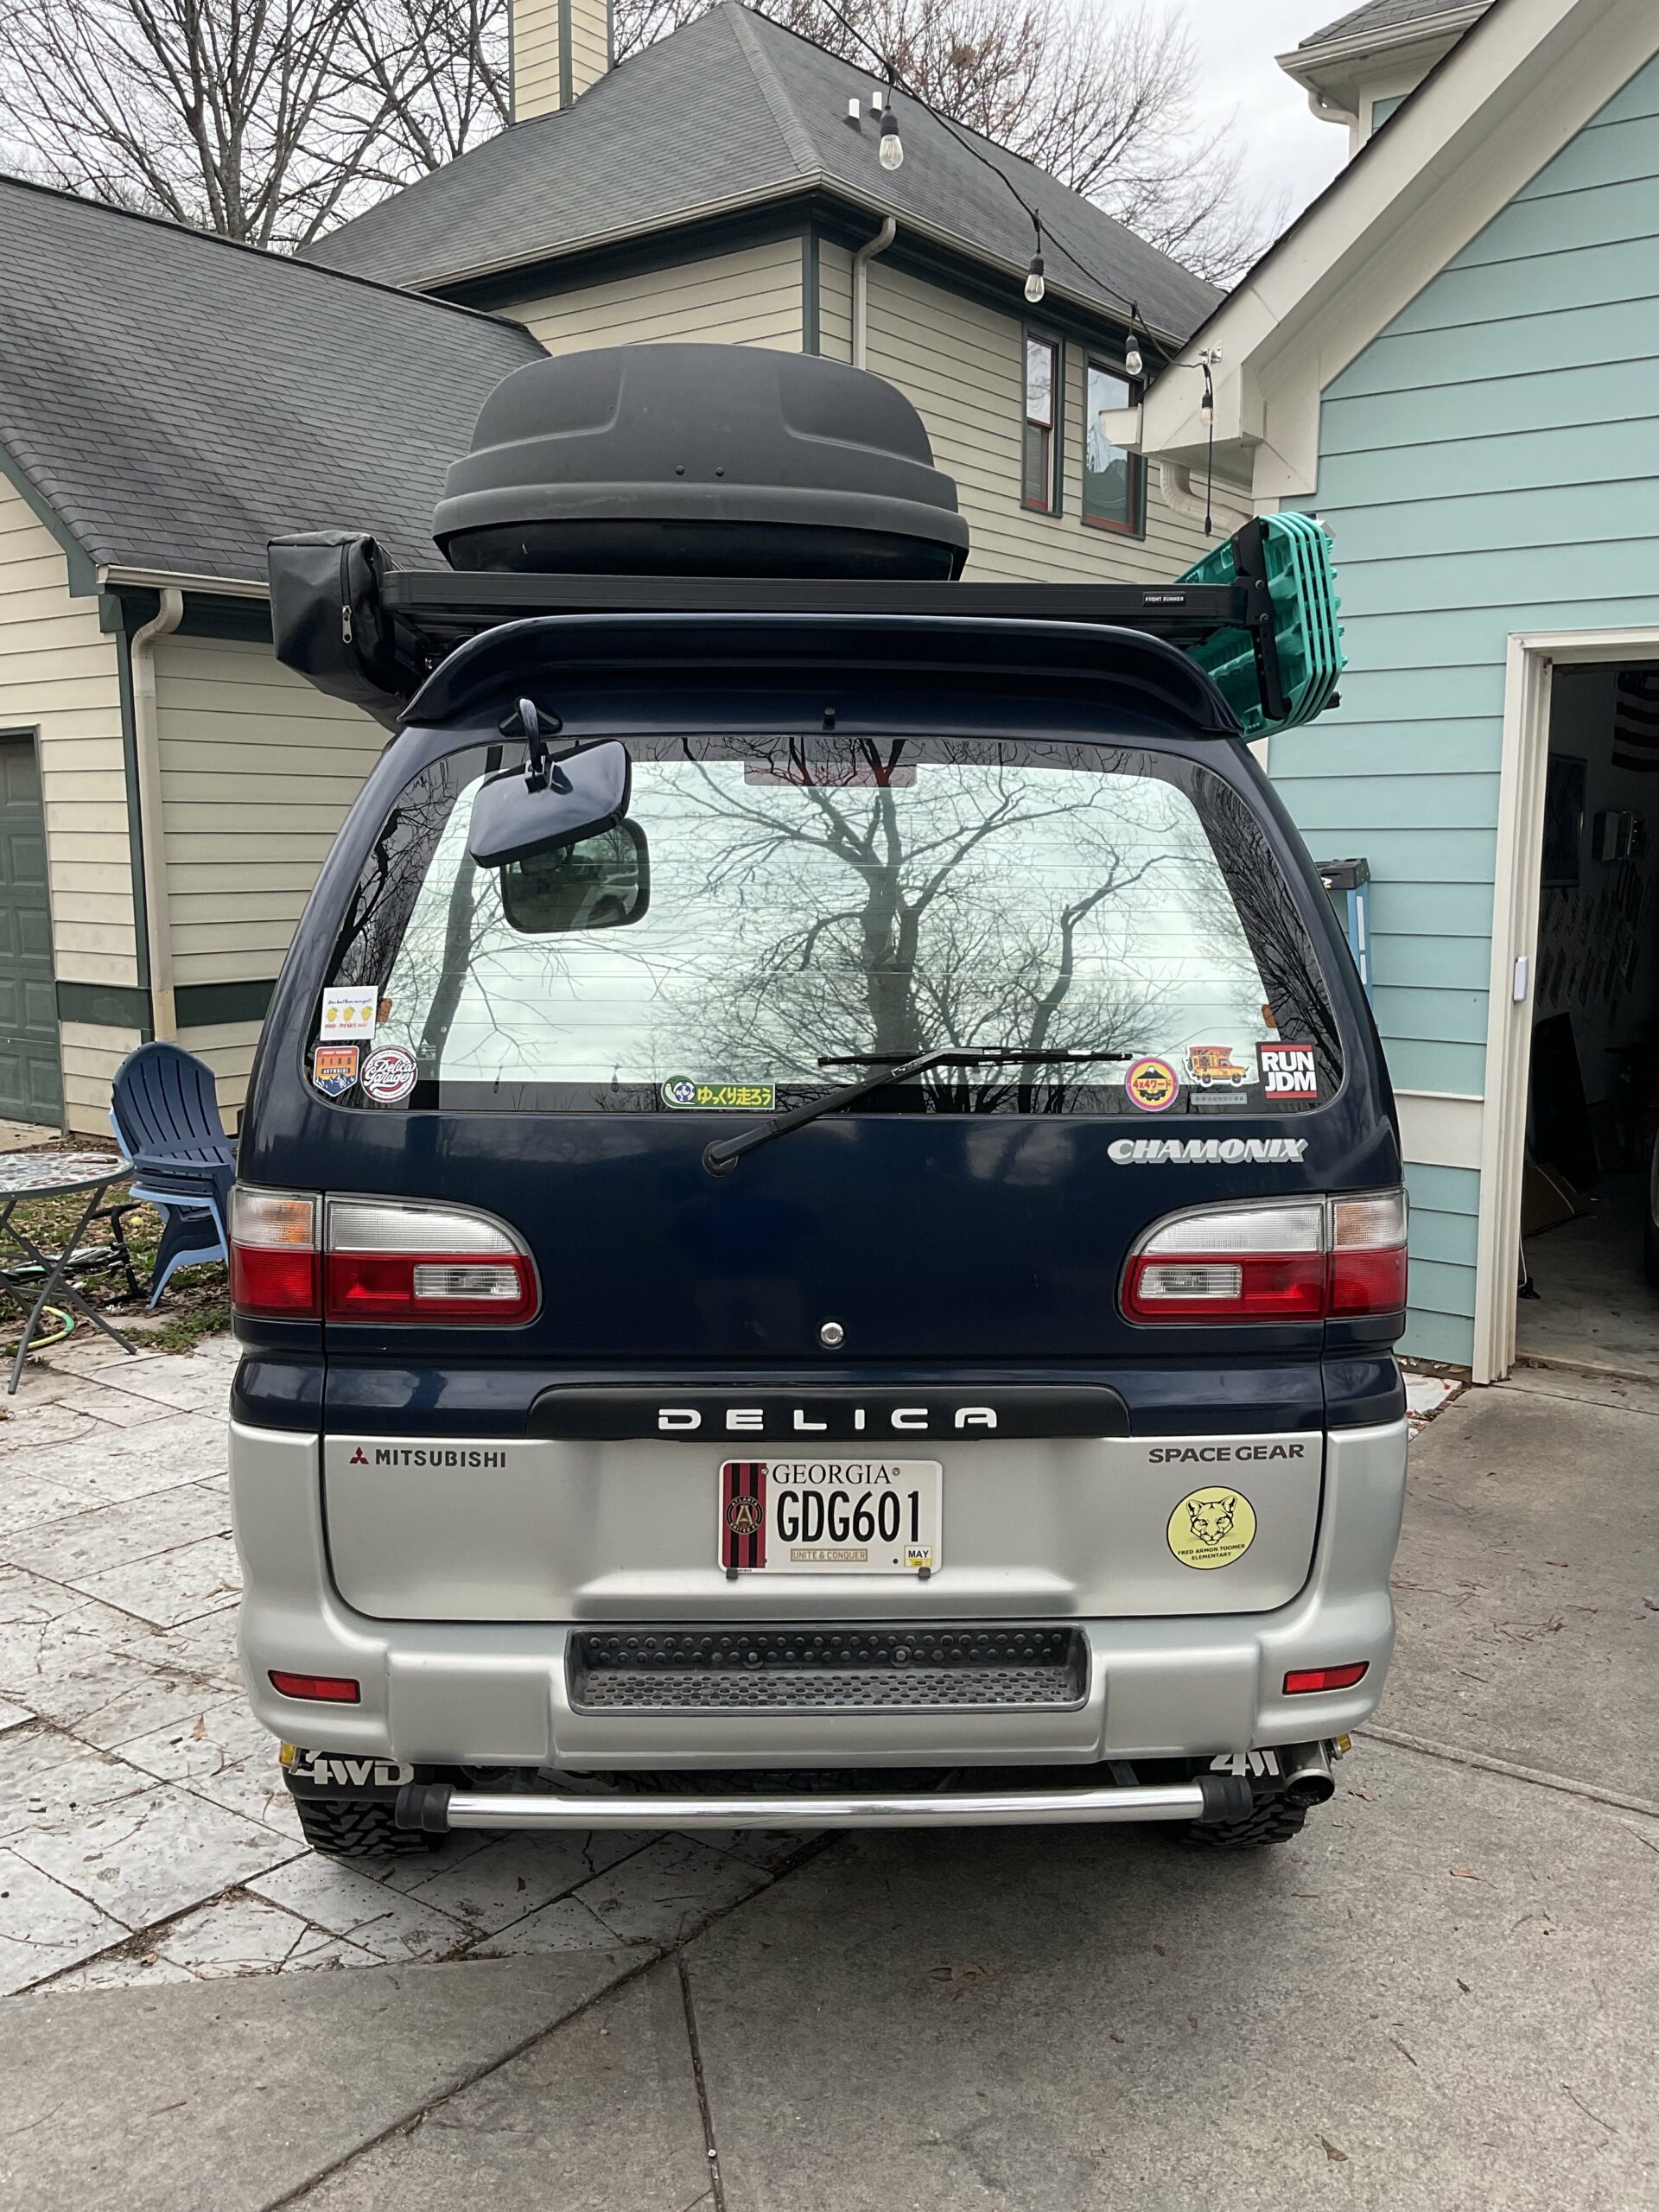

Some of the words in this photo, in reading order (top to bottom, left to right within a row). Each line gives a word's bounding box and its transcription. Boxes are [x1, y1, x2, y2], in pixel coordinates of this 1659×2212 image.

[374, 1058, 416, 1074] Delica
[1261, 1051, 1315, 1071] RUN
[364, 1066, 410, 1091] Garage
[1264, 1071, 1317, 1092] JDM
[697, 1085, 772, 1106] ゆっくり走ろう
[1107, 1138, 1309, 1165] CHAMONIX
[658, 1407, 998, 1431] DELICA
[375, 1448, 506, 1468] MITSUBISHI
[1148, 1446, 1231, 1464] SPACE
[1235, 1444, 1305, 1461] GEAR
[772, 1464, 892, 1484] GEORGIA
[731, 1497, 757, 1507] ATLANTA
[776, 1490, 920, 1542] GDG601
[730, 1522, 751, 1533] UNITED
[793, 1551, 817, 1560] UNITE
[818, 1551, 825, 1560] &
[826, 1551, 866, 1560] CONQUER
[908, 1549, 929, 1559] MAY
[1192, 1552, 1231, 1560] ELEMENTARY
[1219, 1543, 1246, 1552] TOOMER
[289, 1751, 414, 1786] 4WD
